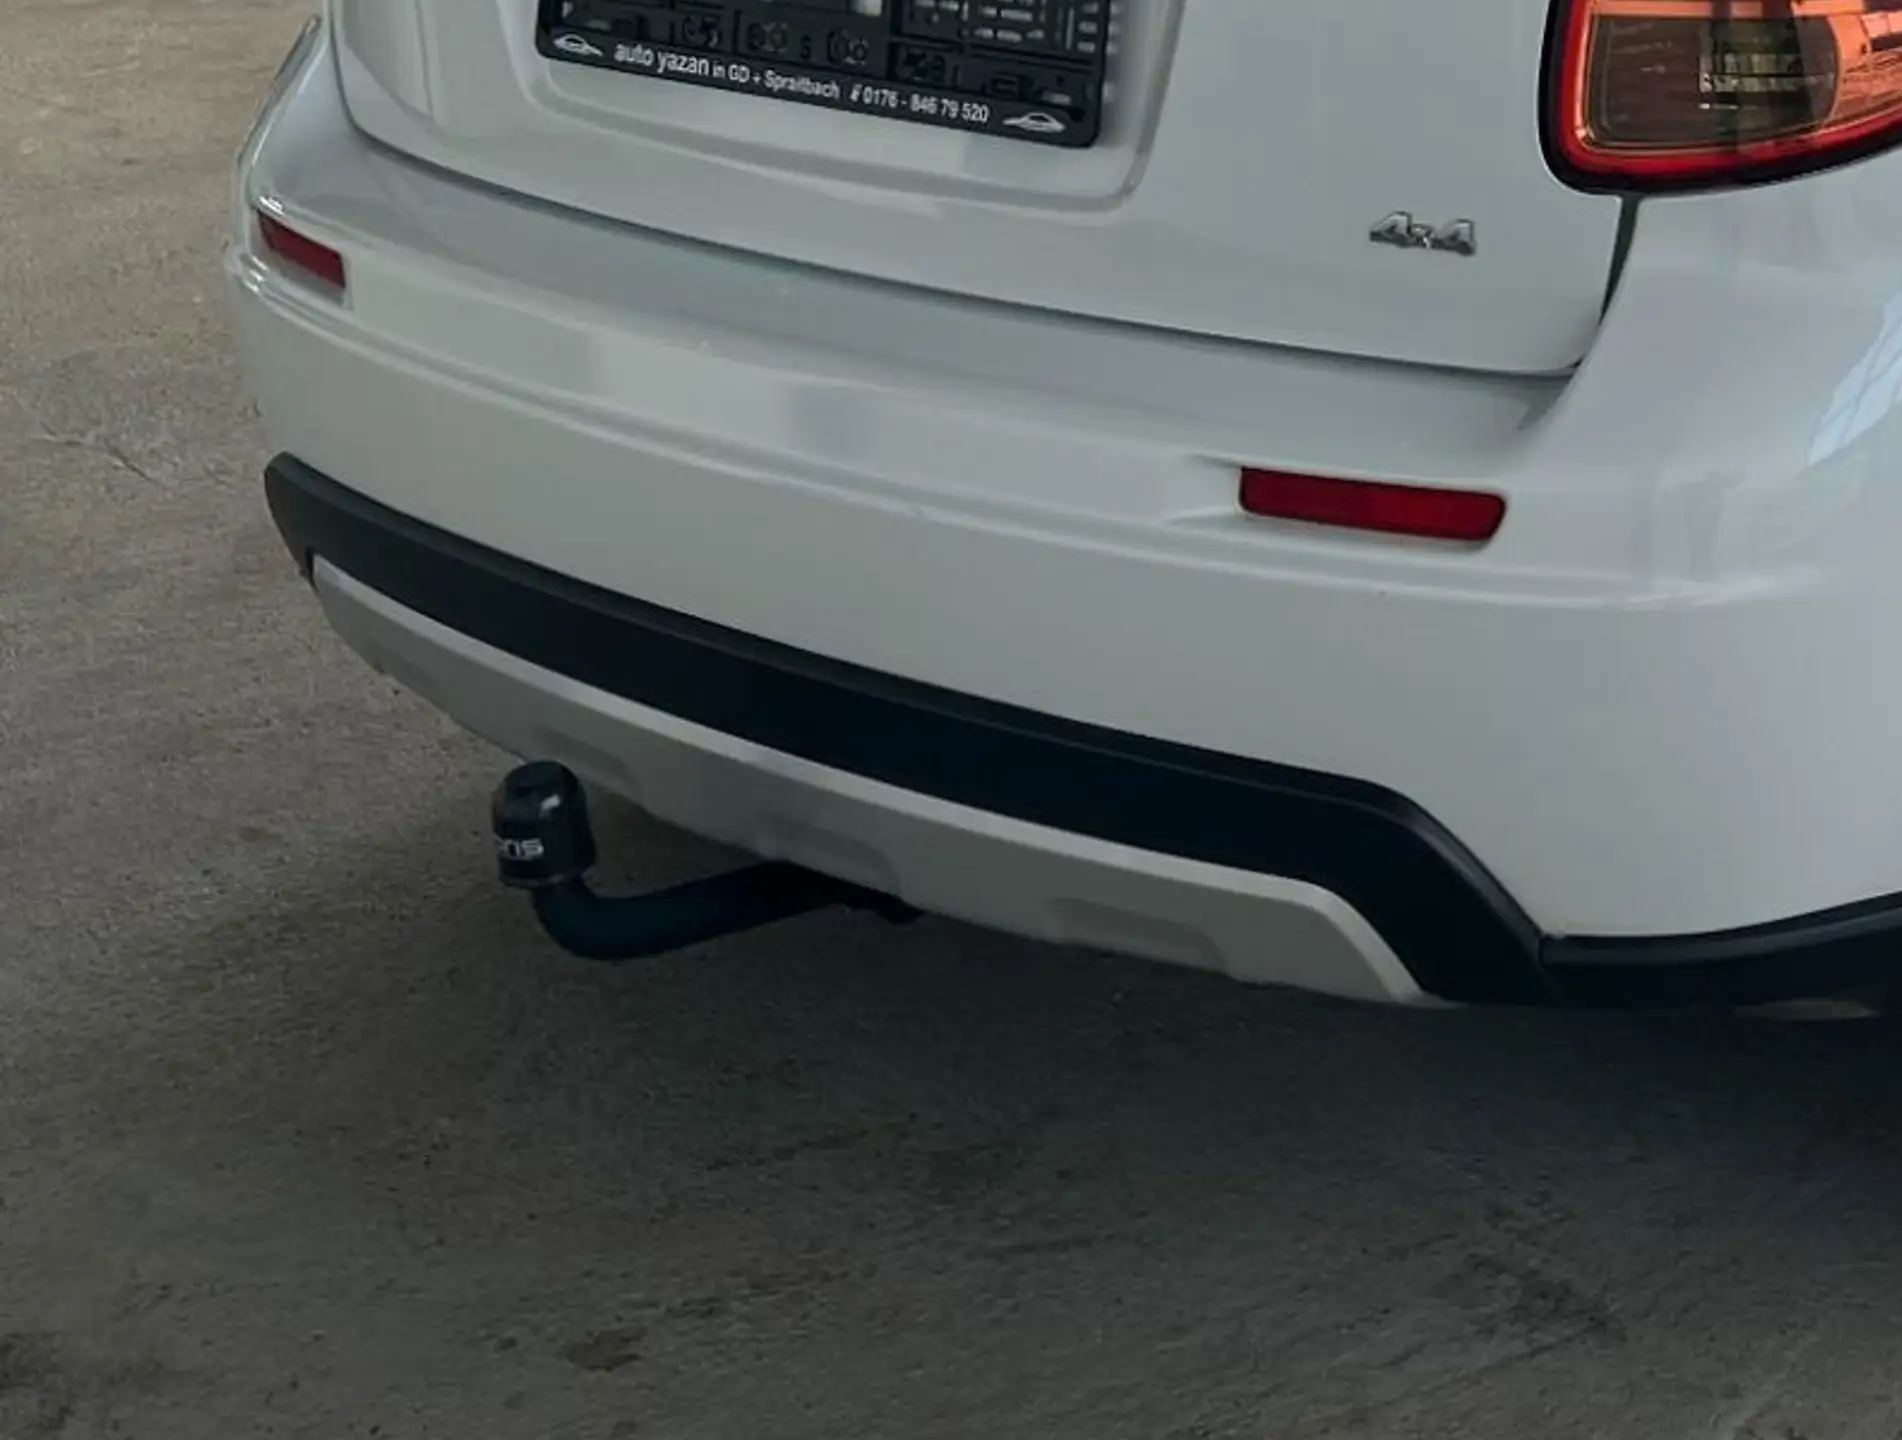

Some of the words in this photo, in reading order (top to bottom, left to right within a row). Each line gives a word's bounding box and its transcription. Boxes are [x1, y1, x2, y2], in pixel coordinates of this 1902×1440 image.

[614, 43, 653, 66] auto
[656, 51, 710, 76] yazan
[712, 63, 726, 78] in
[728, 64, 750, 83] GD
[862, 86, 899, 108] 0176
[941, 99, 959, 119] 79
[961, 102, 990, 123] 520
